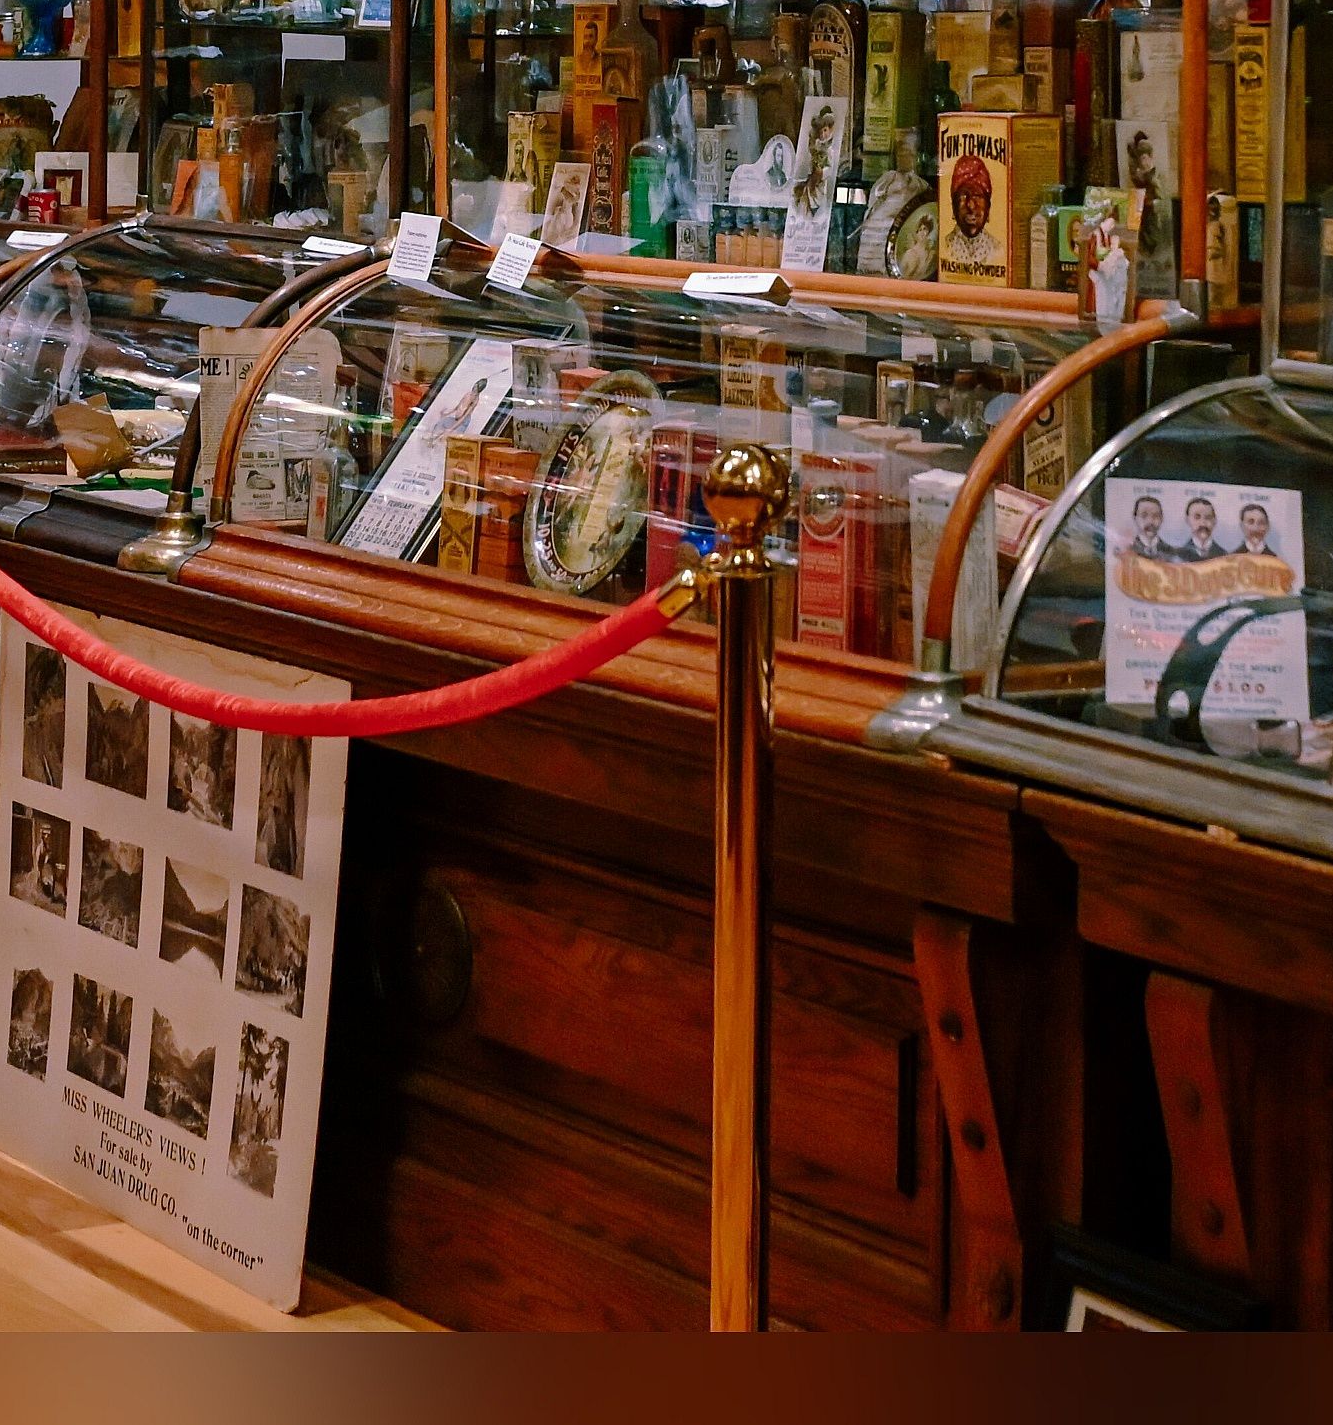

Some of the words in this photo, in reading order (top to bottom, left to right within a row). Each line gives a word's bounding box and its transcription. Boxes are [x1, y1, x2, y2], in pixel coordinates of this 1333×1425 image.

[61, 1086, 87, 1114] MISS
[92, 1100, 153, 1148] WHEELER'S
[159, 1137, 196, 1171] VIEWS
[99, 1131, 117, 1155] For
[118, 1141, 138, 1164] sale
[139, 1152, 153, 1176] by
[73, 1144, 95, 1173] SAN
[96, 1159, 124, 1189] JUAN
[127, 1177, 158, 1207] DRUG
[160, 1193, 178, 1218] CO.
[182, 1214, 200, 1240] "on
[201, 1228, 219, 1252] the
